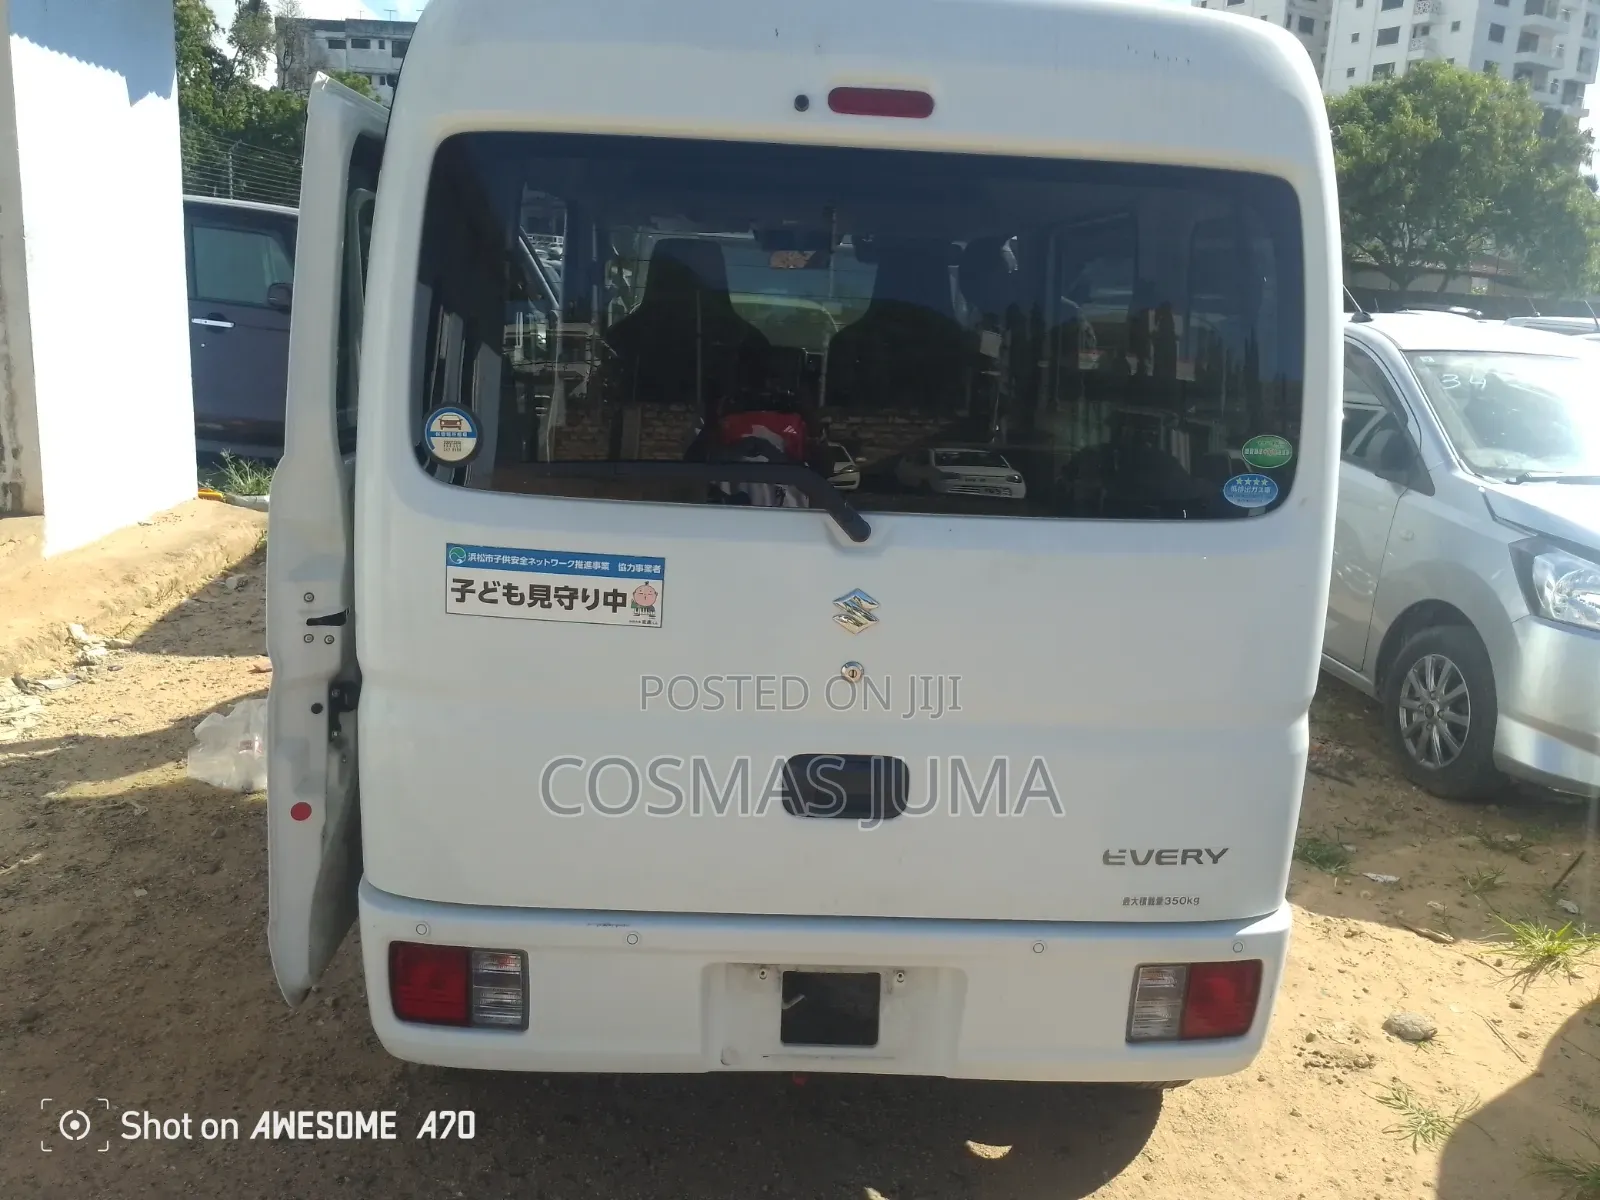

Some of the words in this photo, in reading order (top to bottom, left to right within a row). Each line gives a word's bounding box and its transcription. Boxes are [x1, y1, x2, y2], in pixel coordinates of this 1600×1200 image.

[468, 552, 610, 571] 浜松市子供安全ネットワーク推進事業
[618, 562, 662, 574] 協力事業者
[450, 578, 628, 613] 子ども見守り中
[1102, 848, 1229, 866] EVERY
[1122, 896, 1200, 906] 最大積載量350kg
